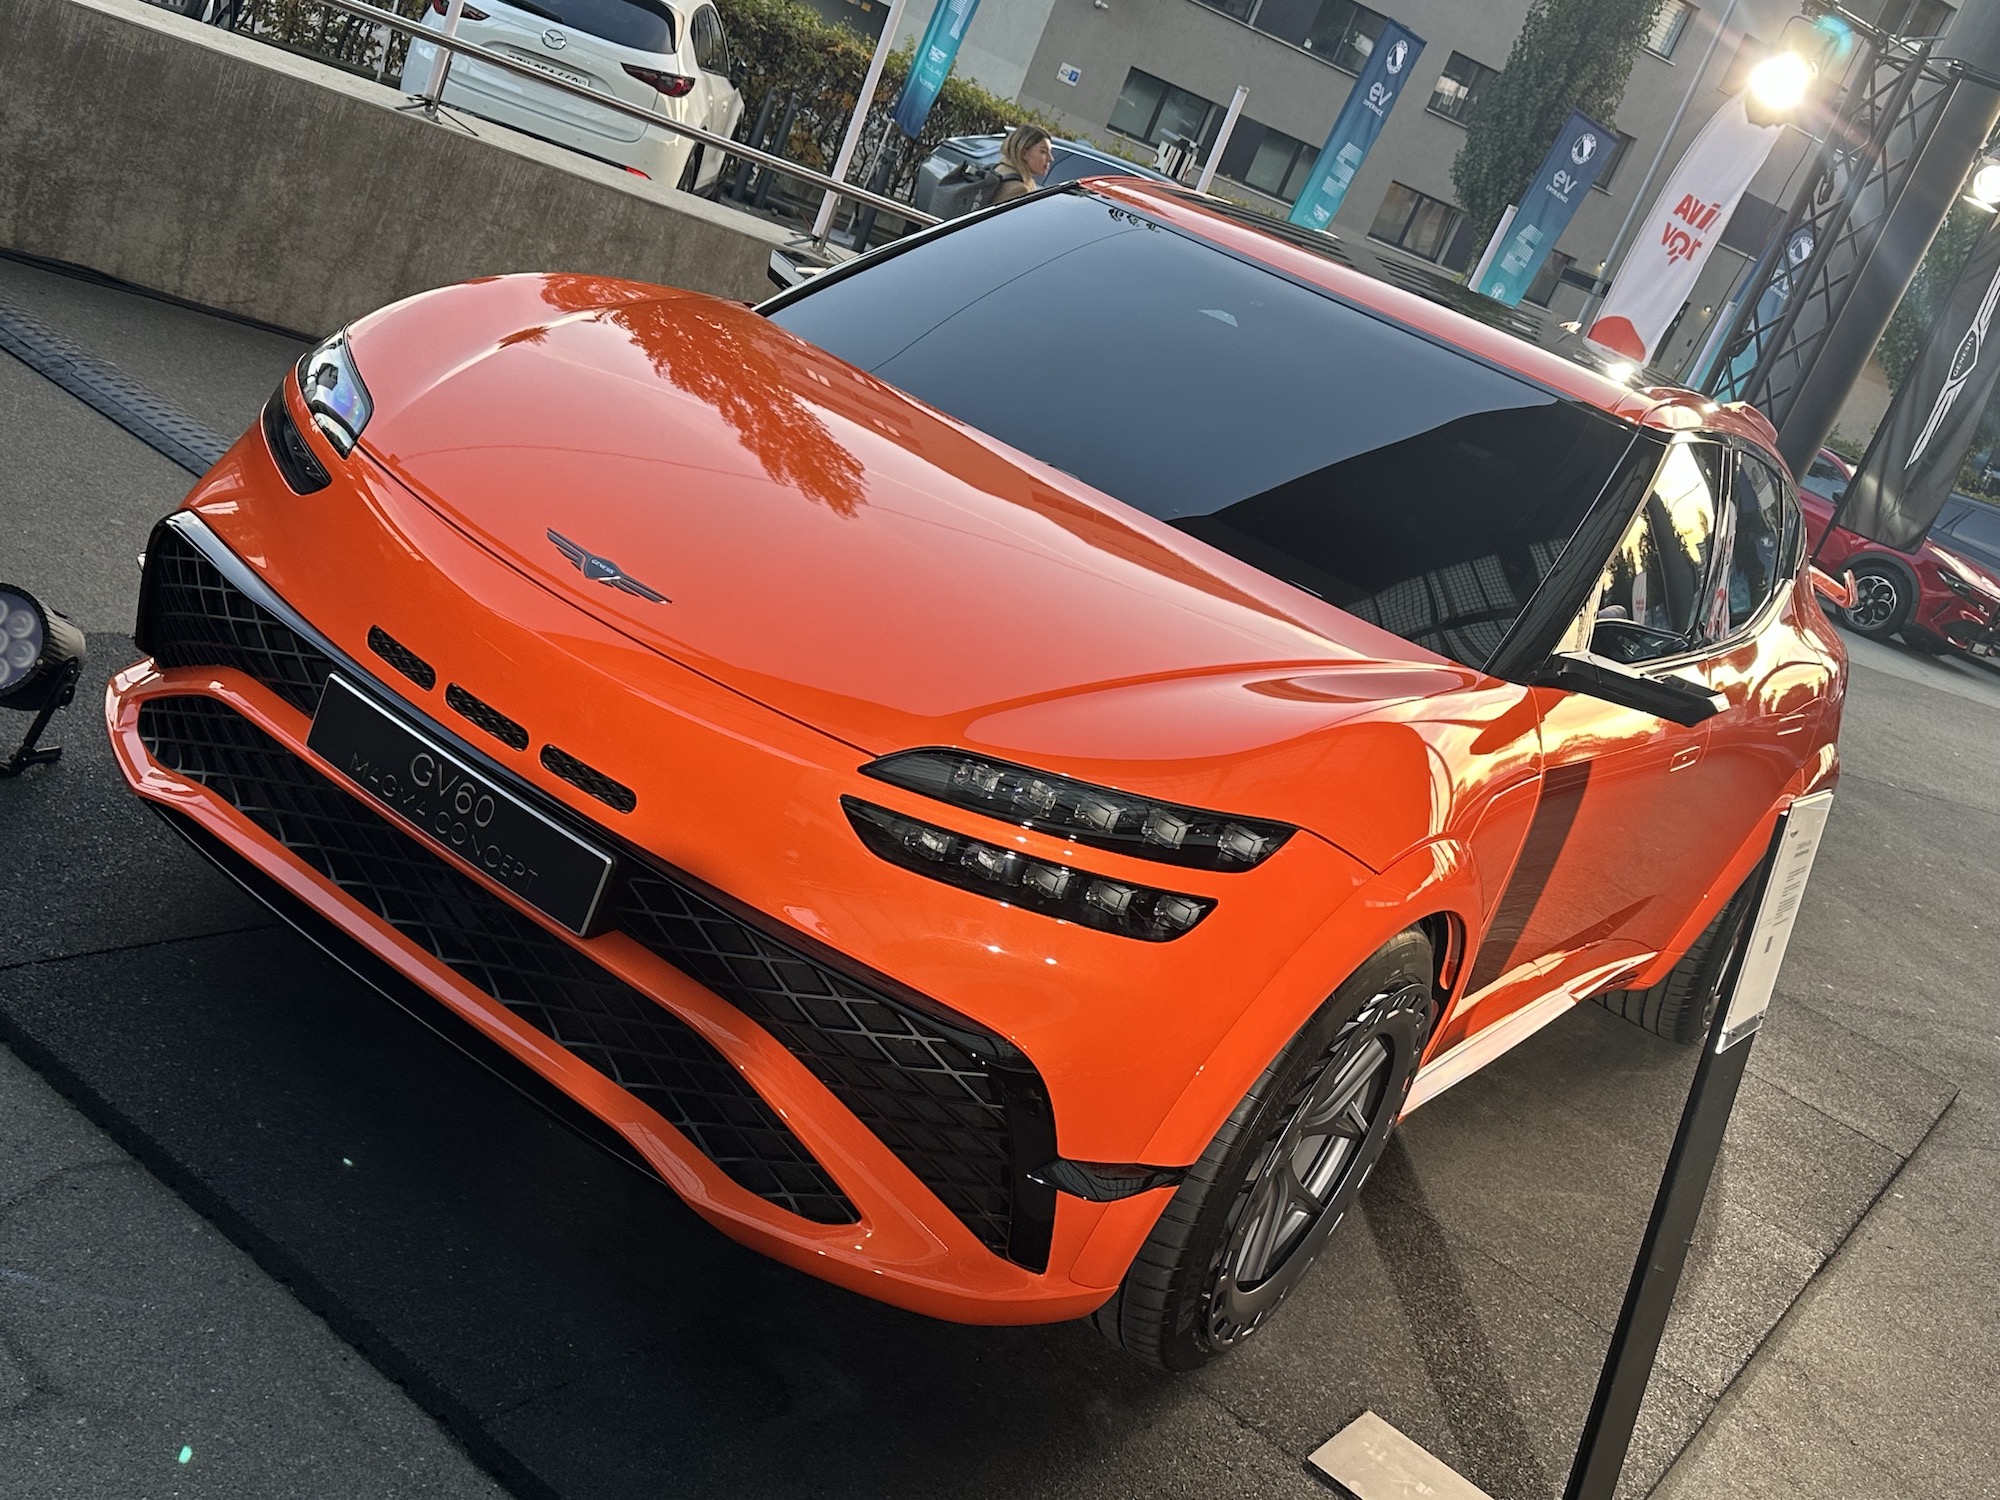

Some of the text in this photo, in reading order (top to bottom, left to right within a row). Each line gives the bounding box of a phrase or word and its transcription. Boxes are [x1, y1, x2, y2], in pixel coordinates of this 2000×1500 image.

[1953, 336, 1974, 377] GENESIS
[410, 752, 495, 828] GV60
[435, 809, 539, 893] CONCEPT
